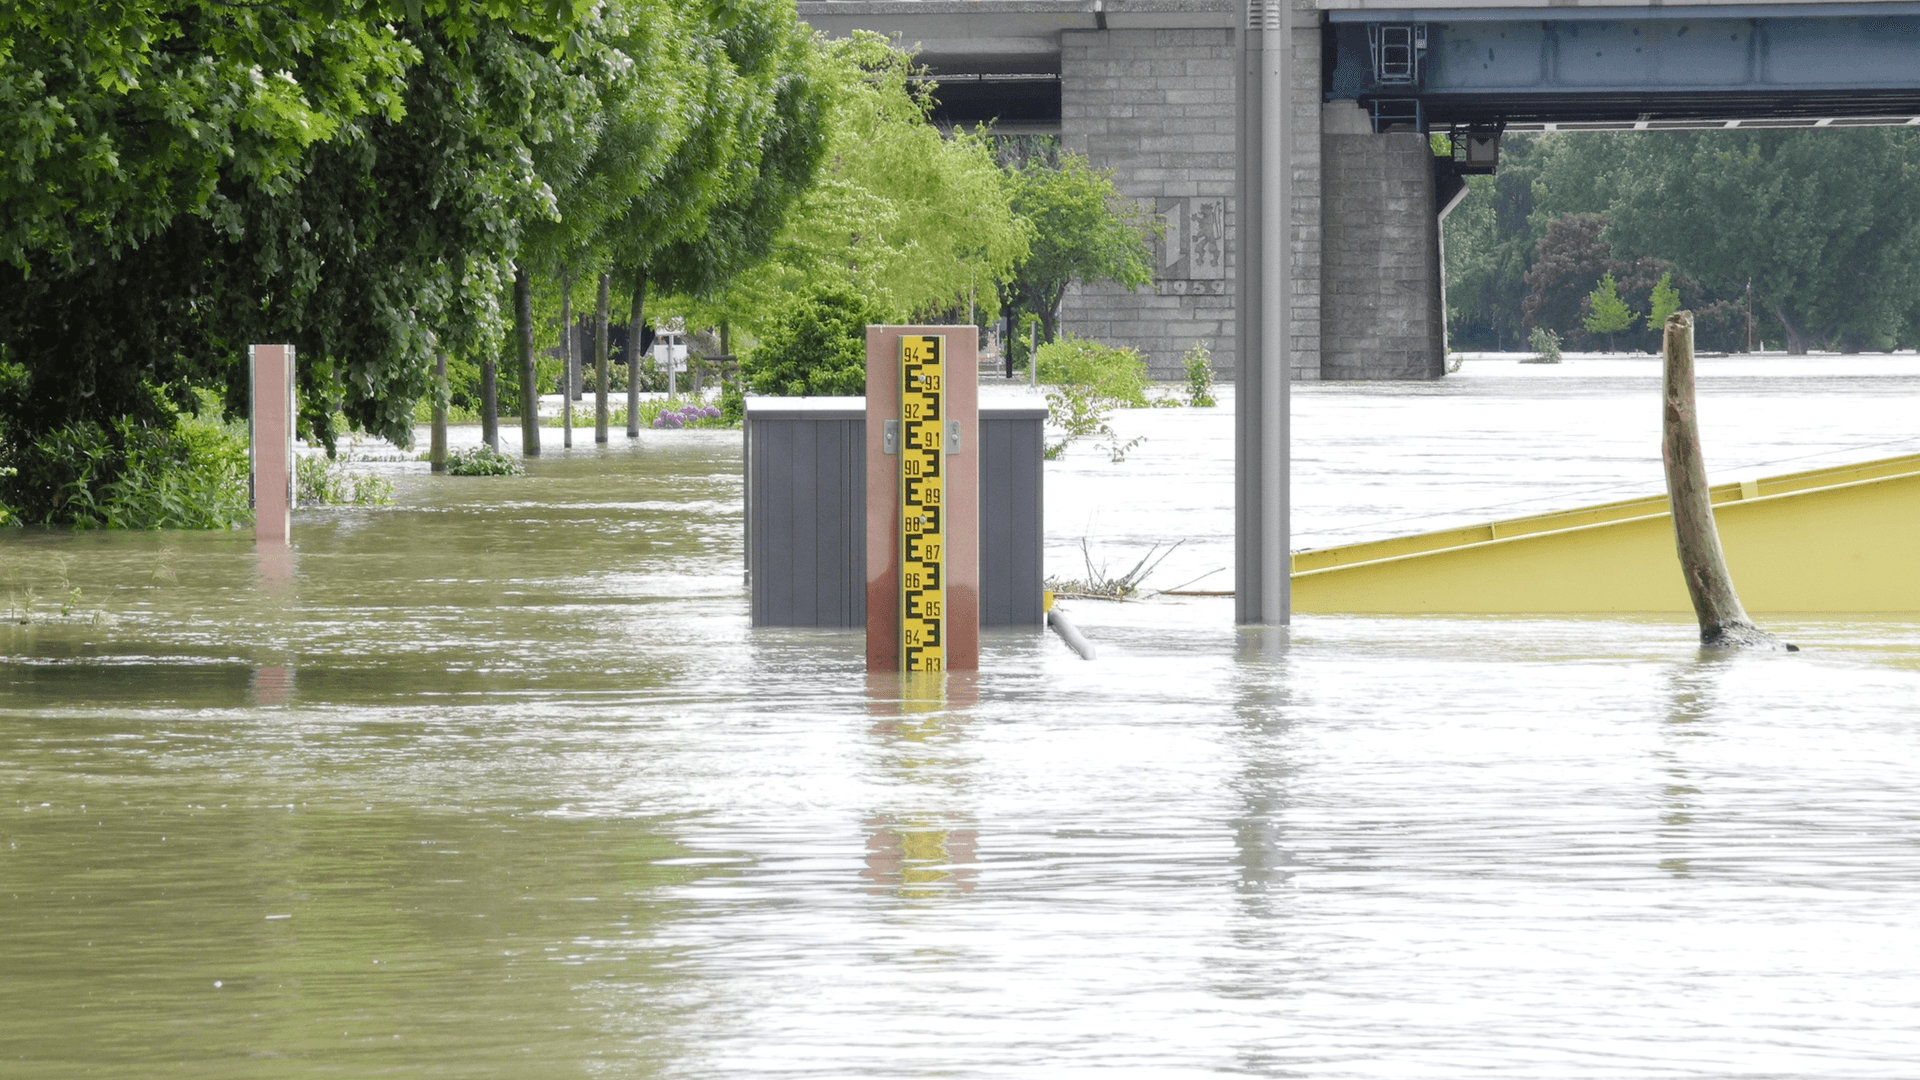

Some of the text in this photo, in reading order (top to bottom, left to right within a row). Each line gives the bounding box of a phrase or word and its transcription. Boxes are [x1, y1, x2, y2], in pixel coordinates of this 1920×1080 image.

[1159, 281, 1224, 295] 1959
[904, 347, 919, 362] 94
[925, 376, 939, 390] 93
[905, 404, 919, 419] 92
[925, 432, 939, 447] 91
[905, 460, 919, 475] 90
[926, 489, 940, 503] 89
[906, 517, 919, 532] 88
[926, 545, 940, 559] 87
[906, 573, 920, 588] 86
[926, 602, 940, 616] 85
[906, 630, 919, 645] 84
[926, 658, 941, 672] 83
